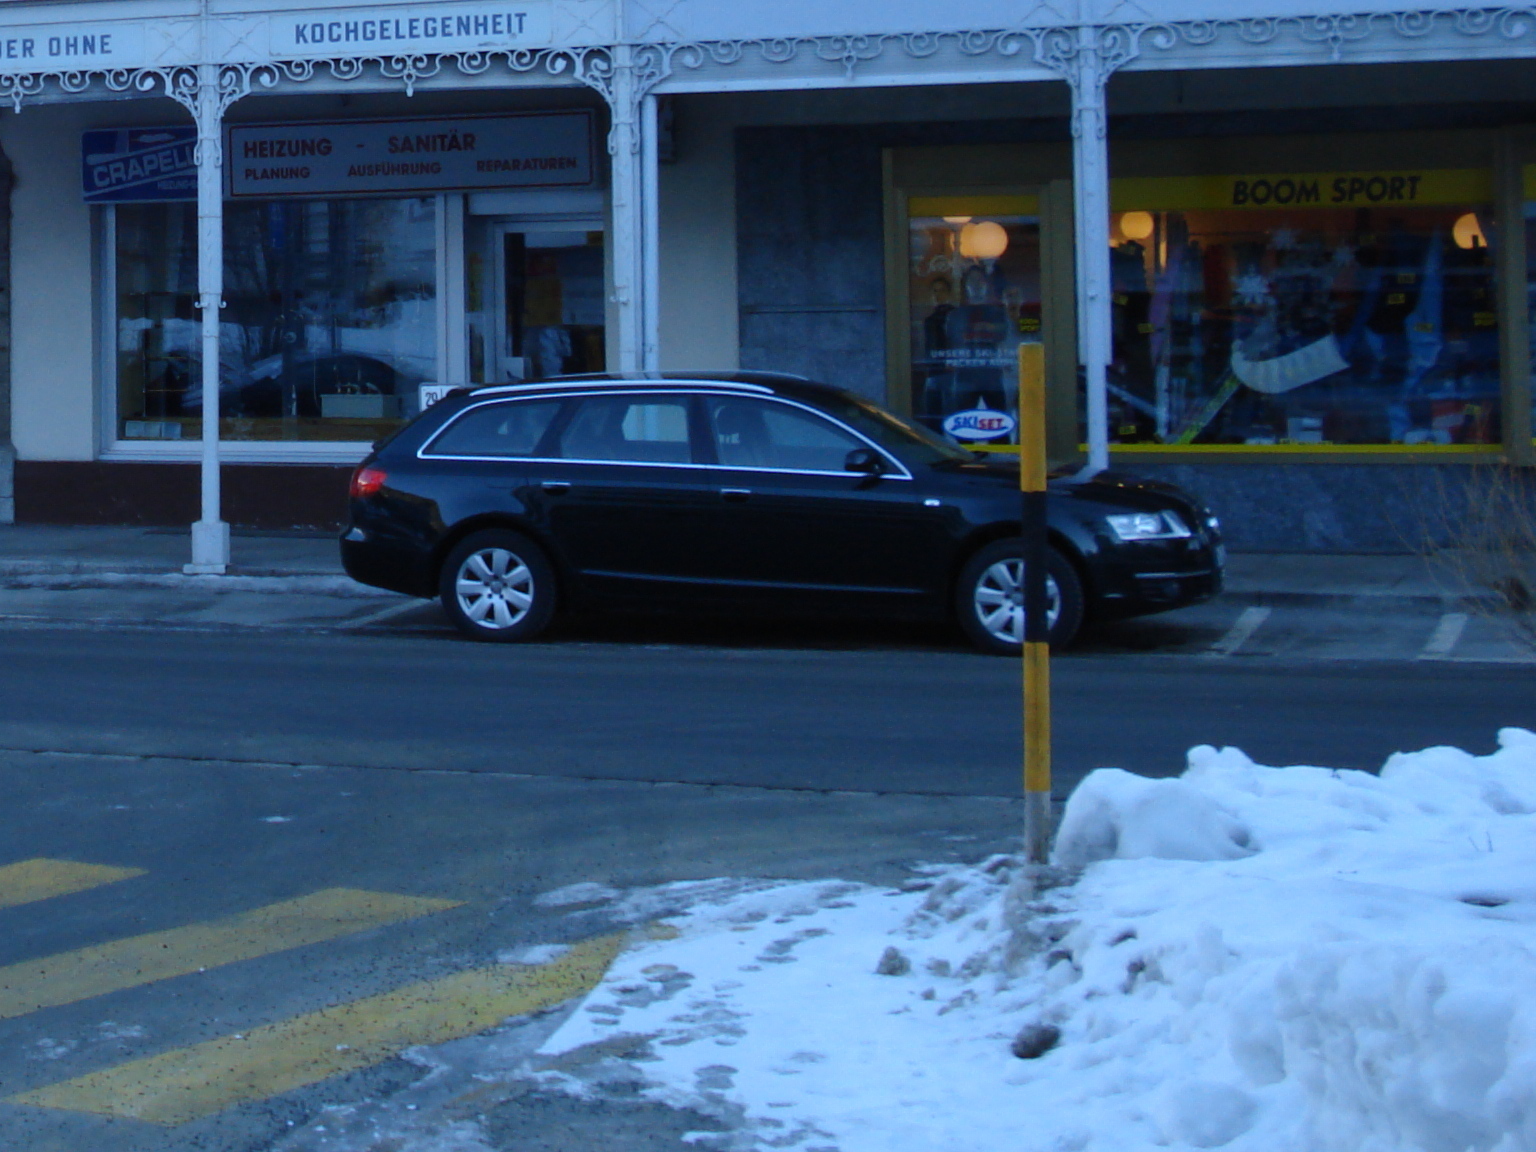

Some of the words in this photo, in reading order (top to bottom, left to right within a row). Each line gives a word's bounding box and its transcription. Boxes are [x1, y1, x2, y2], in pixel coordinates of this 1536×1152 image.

[294, 12, 528, 46] KOCHGELEGENHEIT
[47, 33, 113, 57] OHNE
[243, 138, 333, 159] HEIZUNG
[387, 128, 477, 155] SANITÄR
[92, 145, 200, 188] CRAPELL
[244, 166, 311, 181] PLANUNG
[346, 161, 442, 178] AUSFÜHRUNG
[475, 156, 578, 173] REPARATUREN
[1232, 178, 1321, 206] BOOM
[1331, 175, 1422, 203] SPORT
